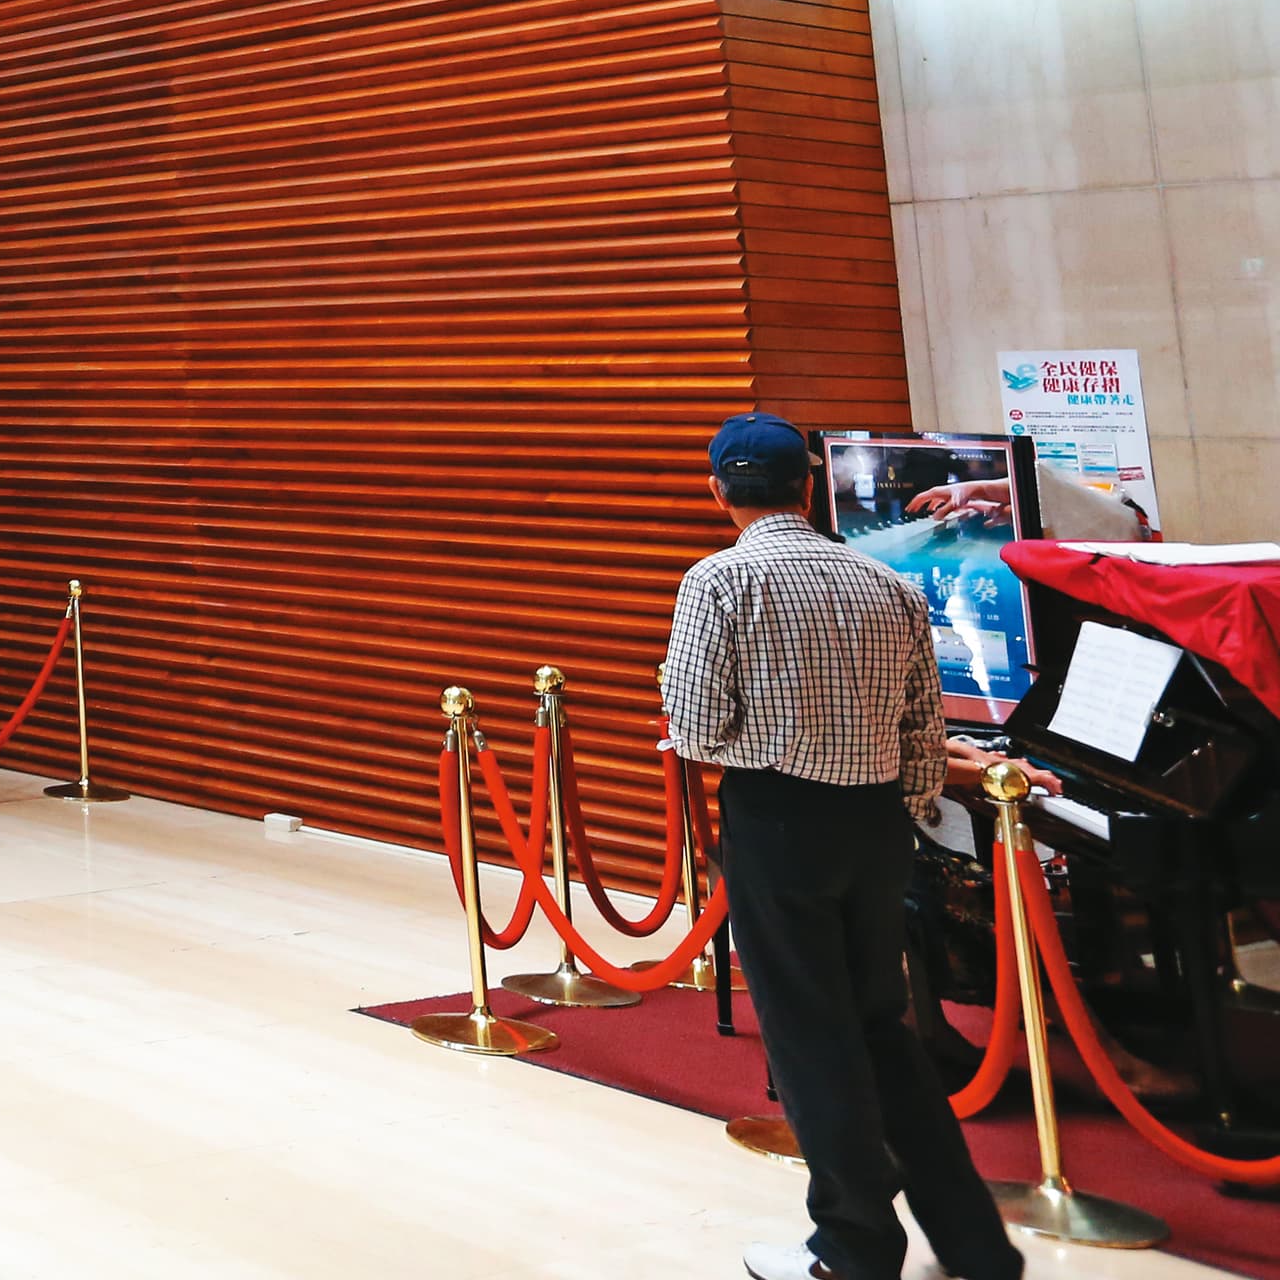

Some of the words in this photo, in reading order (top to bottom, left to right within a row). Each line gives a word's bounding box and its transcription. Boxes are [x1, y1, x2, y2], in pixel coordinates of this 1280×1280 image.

[1040, 360, 1118, 377] 全民健保
[1042, 377, 1121, 393] 健康存摺
